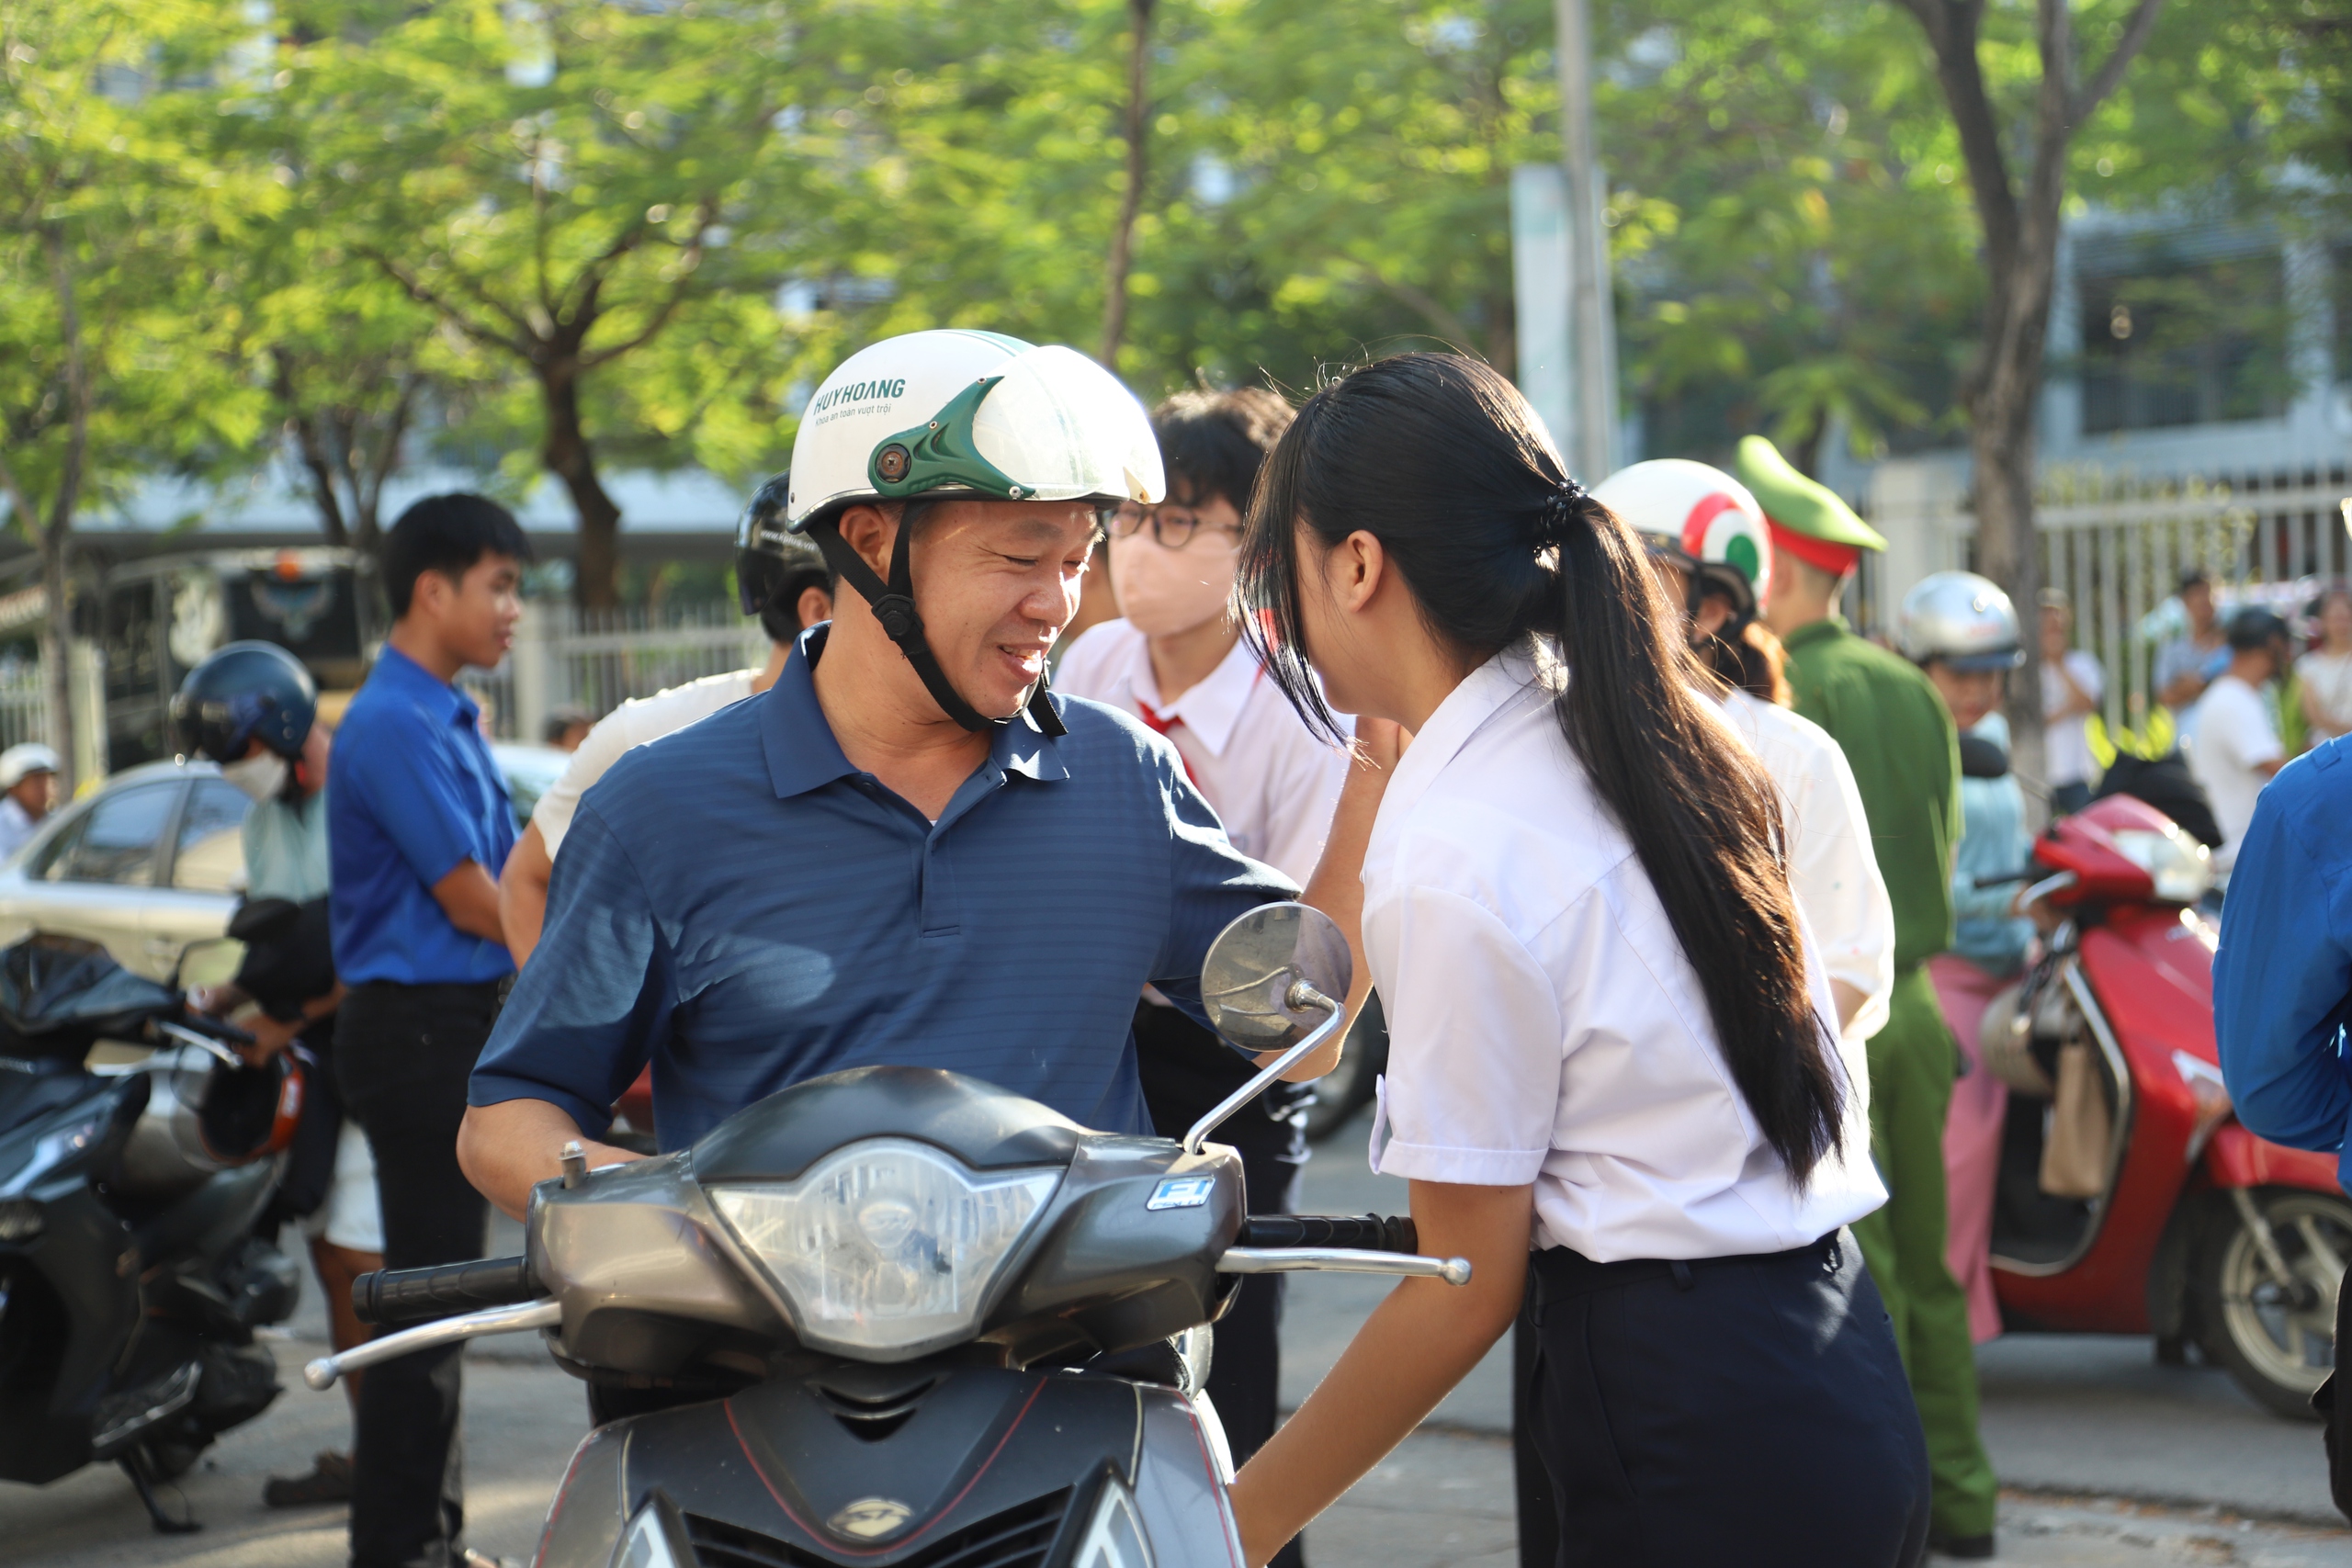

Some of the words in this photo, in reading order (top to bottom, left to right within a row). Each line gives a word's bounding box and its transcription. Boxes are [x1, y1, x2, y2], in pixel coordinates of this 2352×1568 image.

[831, 412, 838, 421] an
[840, 408, 855, 418] toàn
[876, 403, 891, 415] trội
[1159, 1180, 1208, 1198] FI
